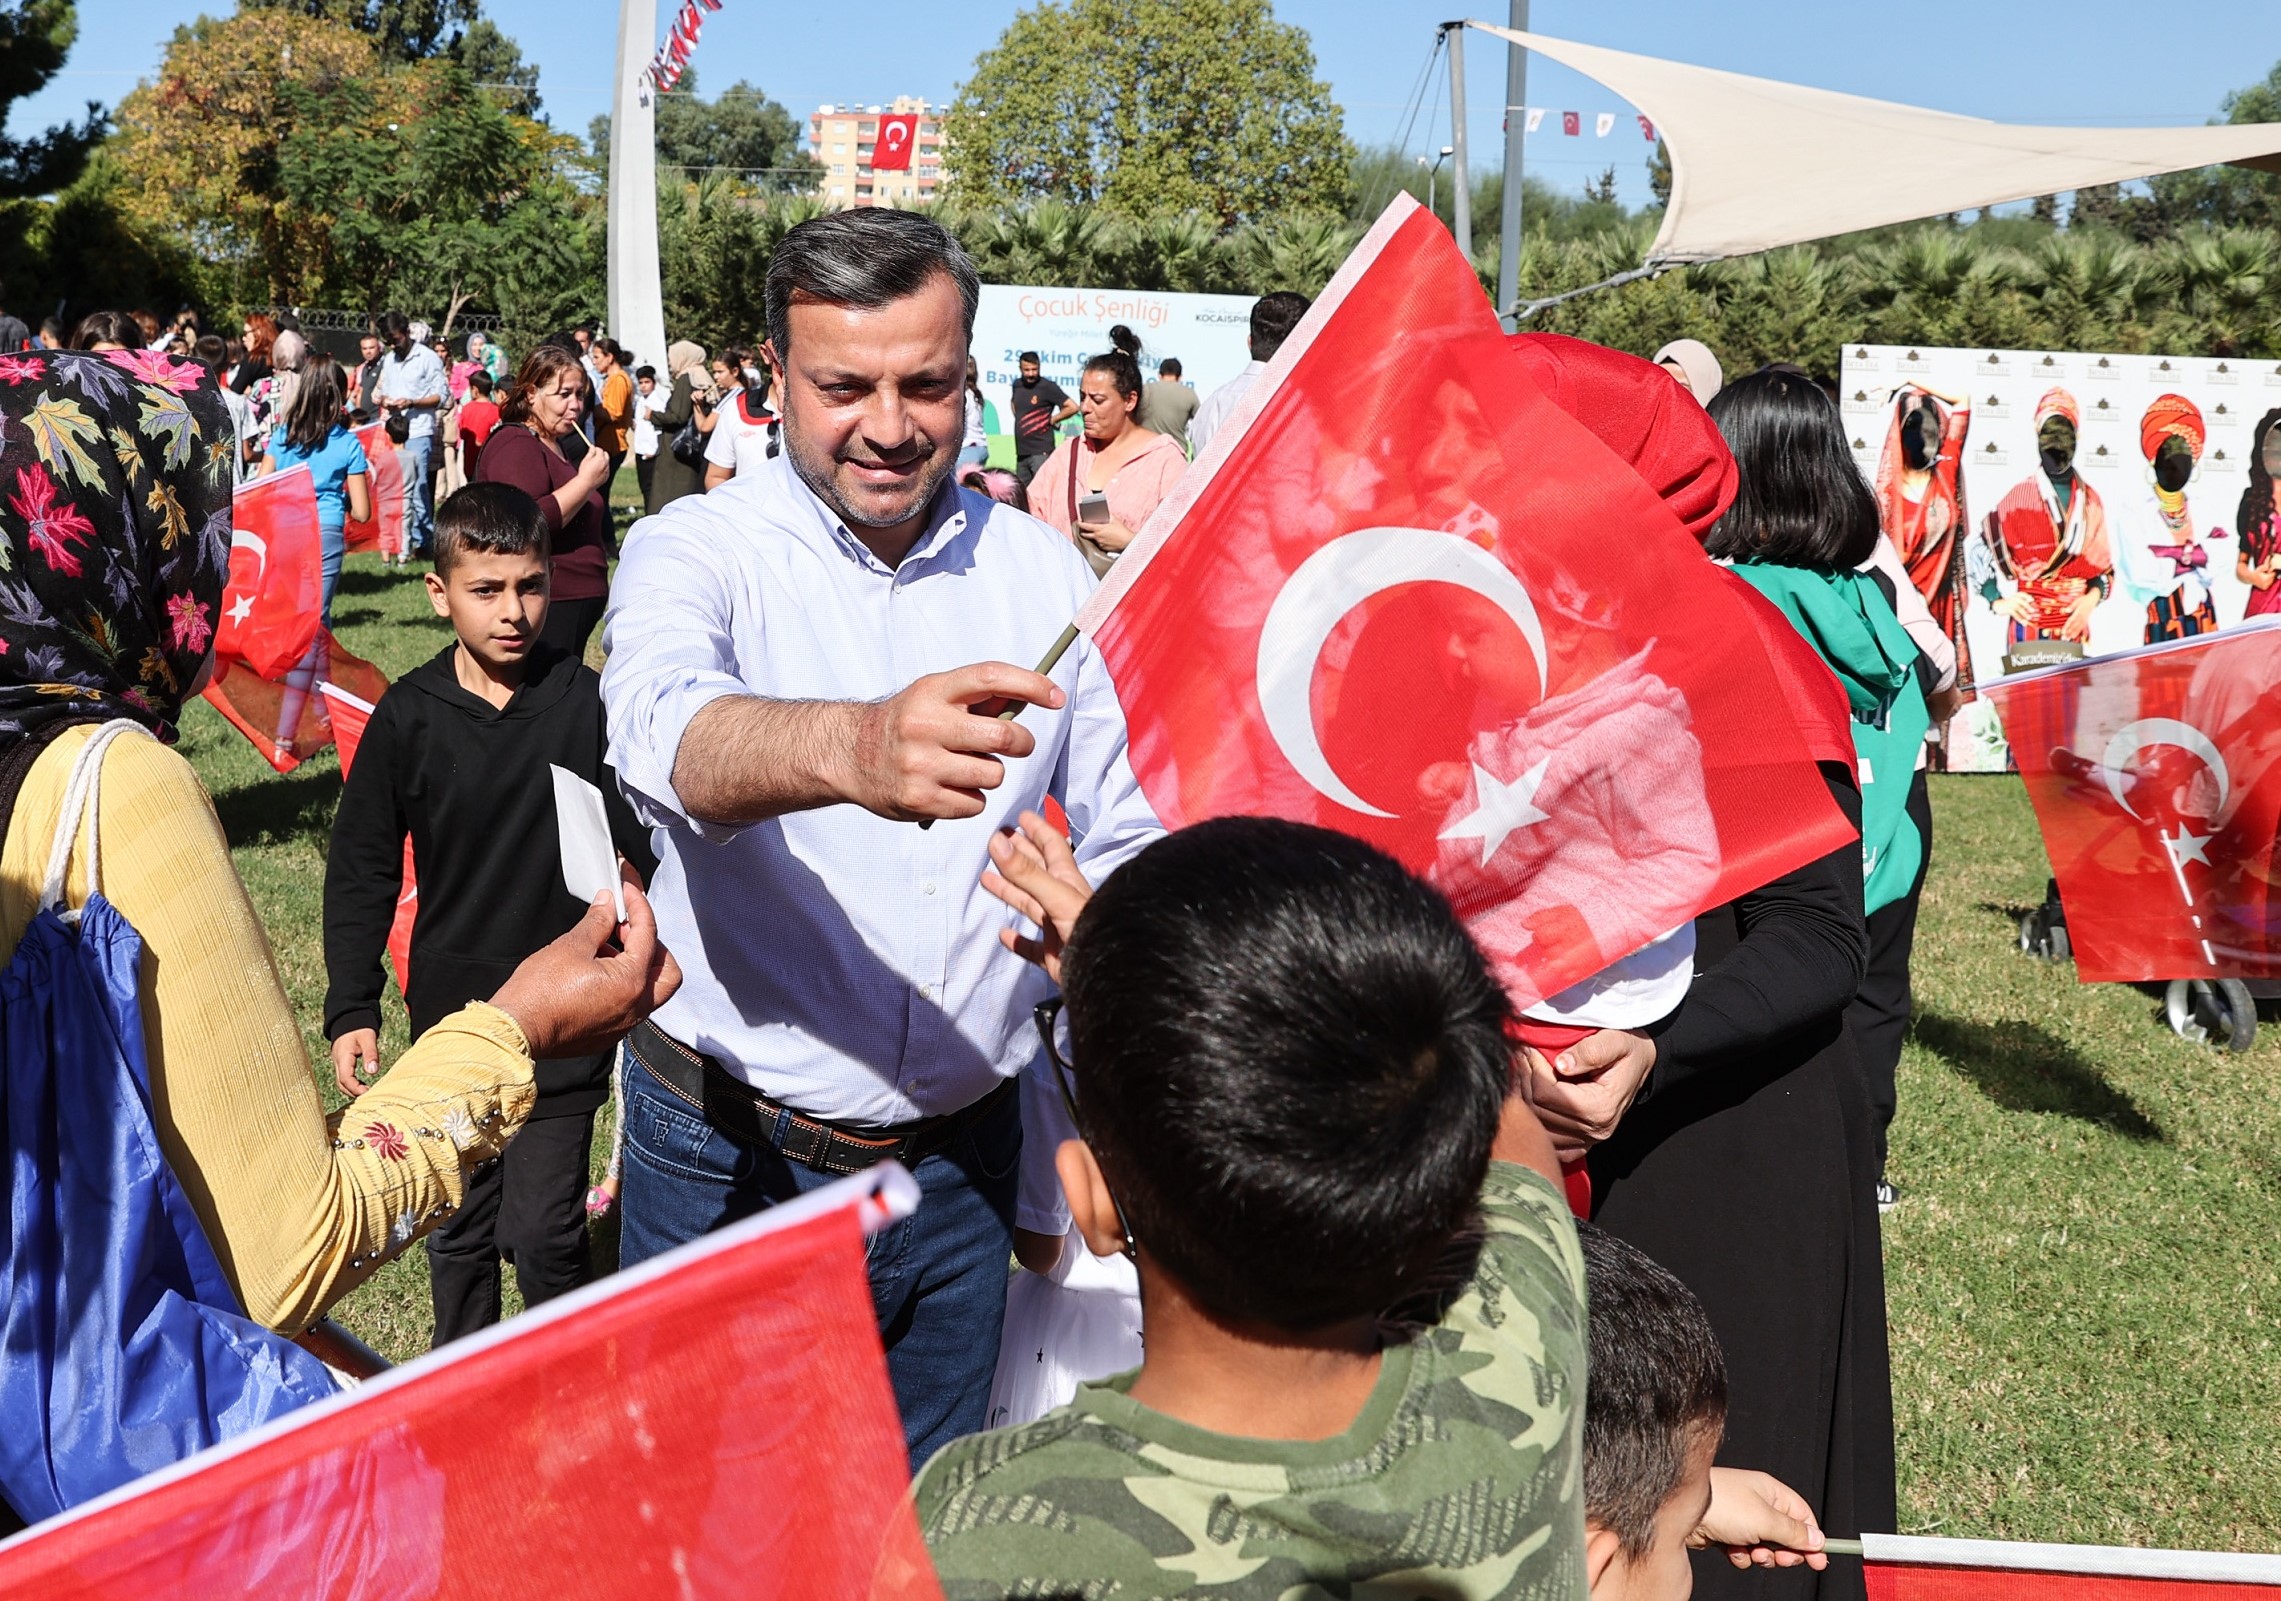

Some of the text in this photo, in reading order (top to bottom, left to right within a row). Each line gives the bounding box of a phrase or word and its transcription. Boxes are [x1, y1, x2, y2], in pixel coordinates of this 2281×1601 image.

[1018, 293, 1169, 328] Çocuk Şenliği
[1036, 350, 1072, 364] kim
